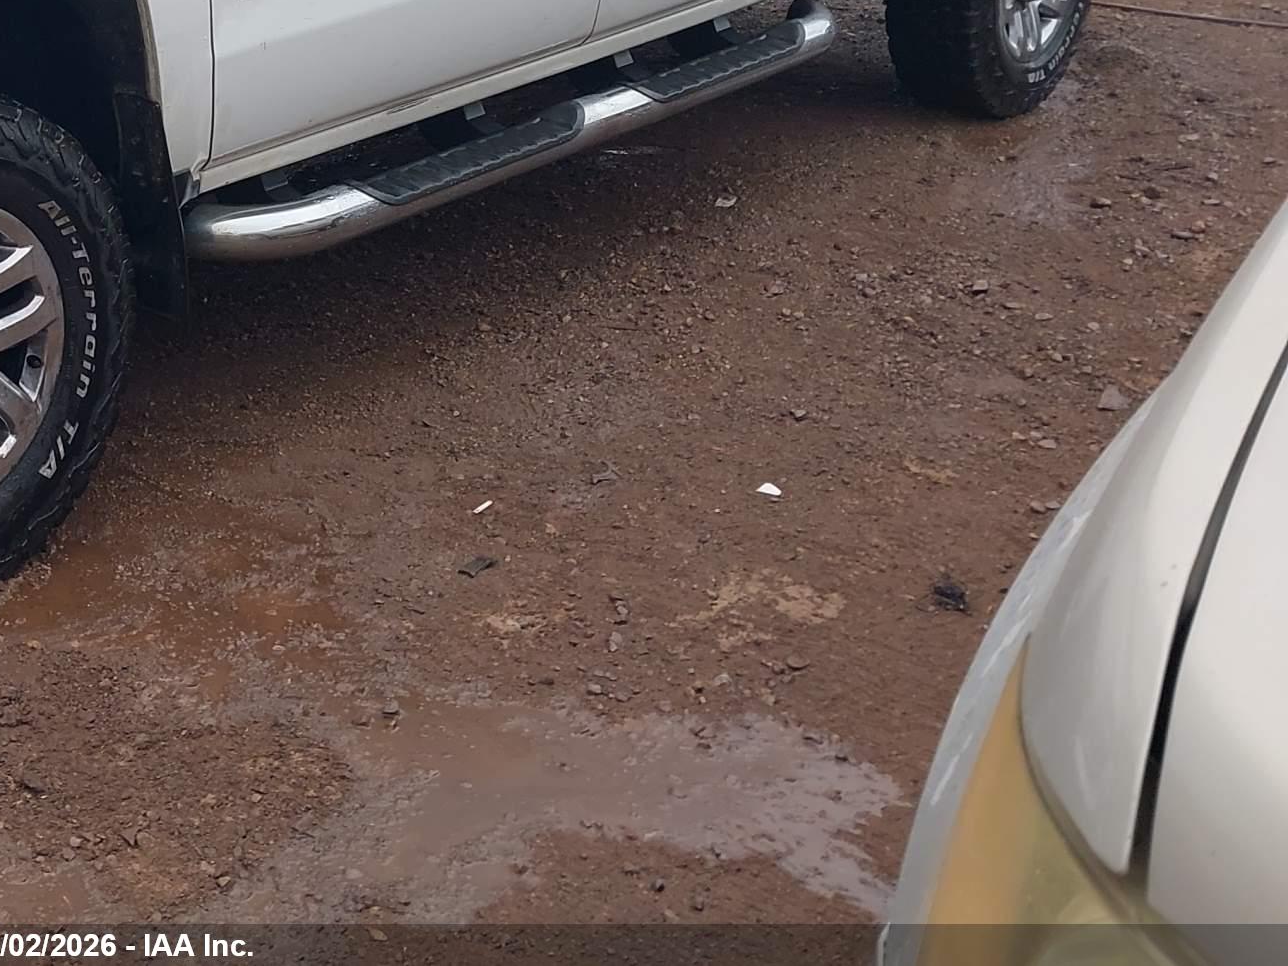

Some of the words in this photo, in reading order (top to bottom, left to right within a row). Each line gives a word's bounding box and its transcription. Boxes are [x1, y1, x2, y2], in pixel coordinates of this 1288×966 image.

[1026, 67, 1048, 84] T/A
[37, 199, 98, 399] All-Terrain
[38, 419, 81, 480] T/A
